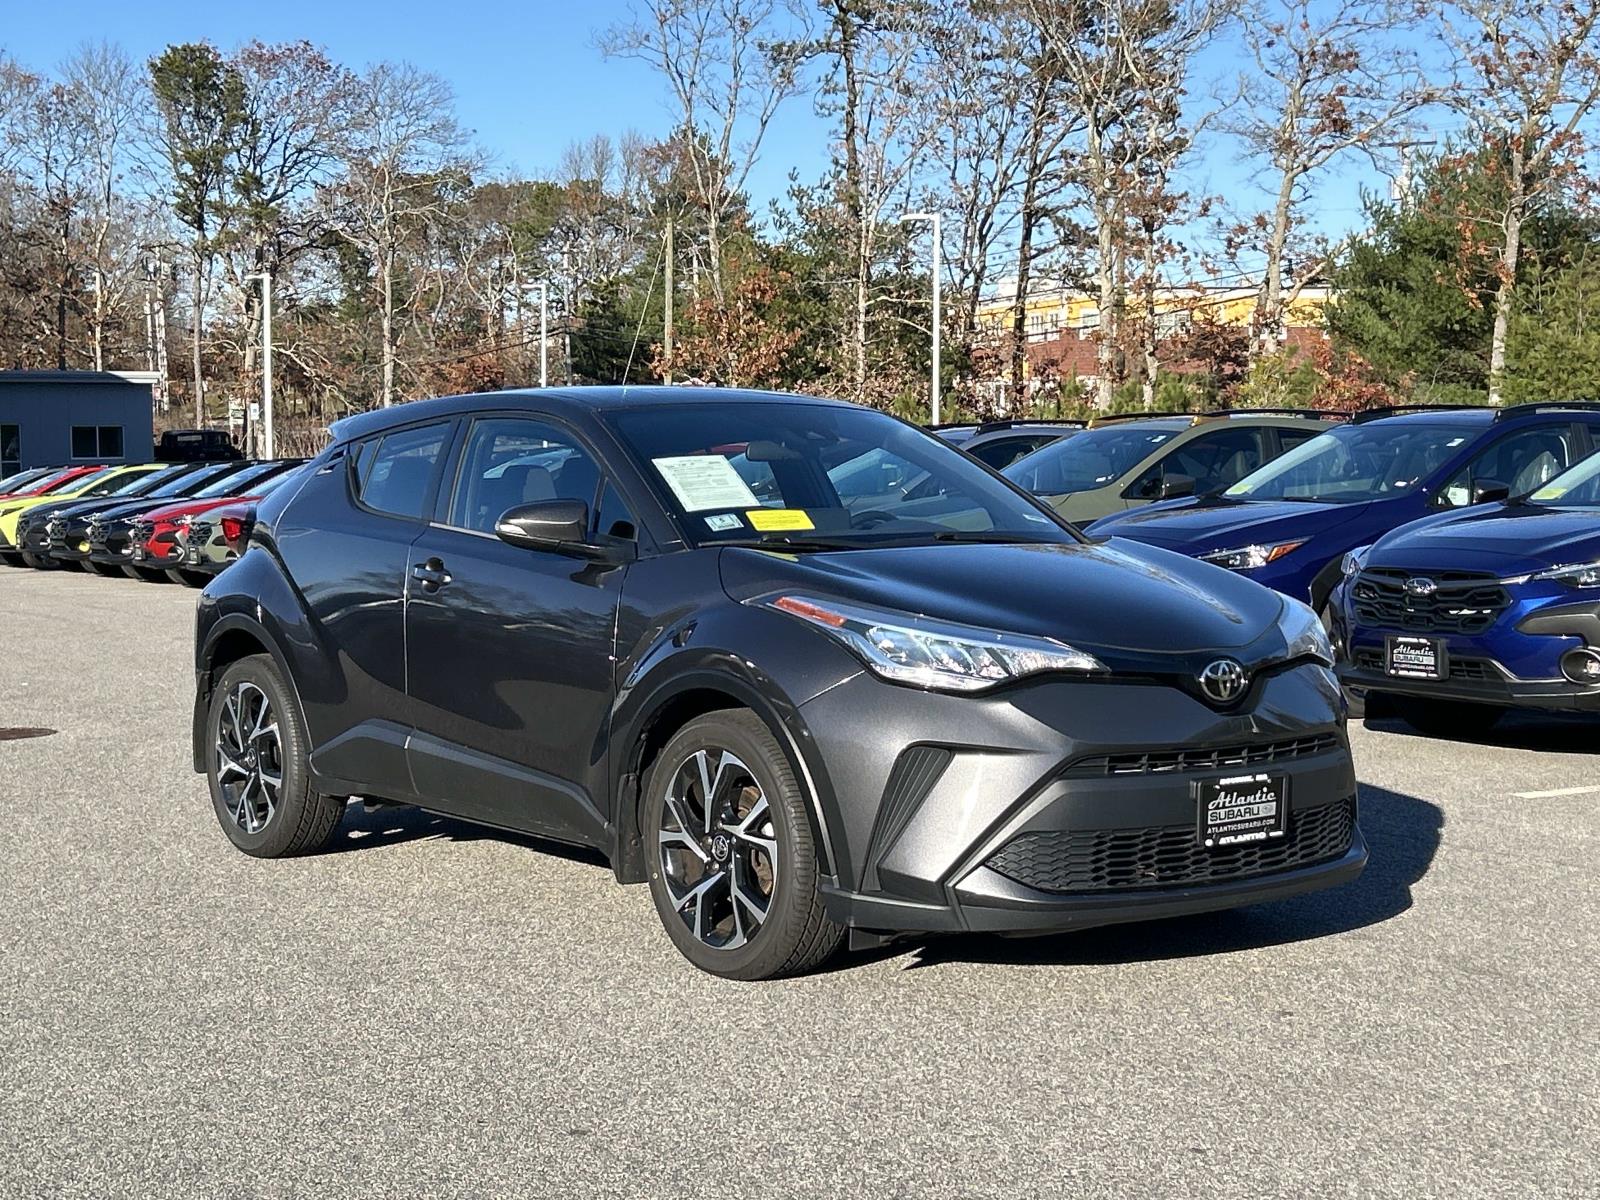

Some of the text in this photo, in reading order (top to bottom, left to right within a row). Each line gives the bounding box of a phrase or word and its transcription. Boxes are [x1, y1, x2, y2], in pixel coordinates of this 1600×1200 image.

[1393, 644, 1434, 656] Atlantic
[1208, 786, 1276, 810] Atlantic
[1209, 806, 1260, 821] SUBARU
